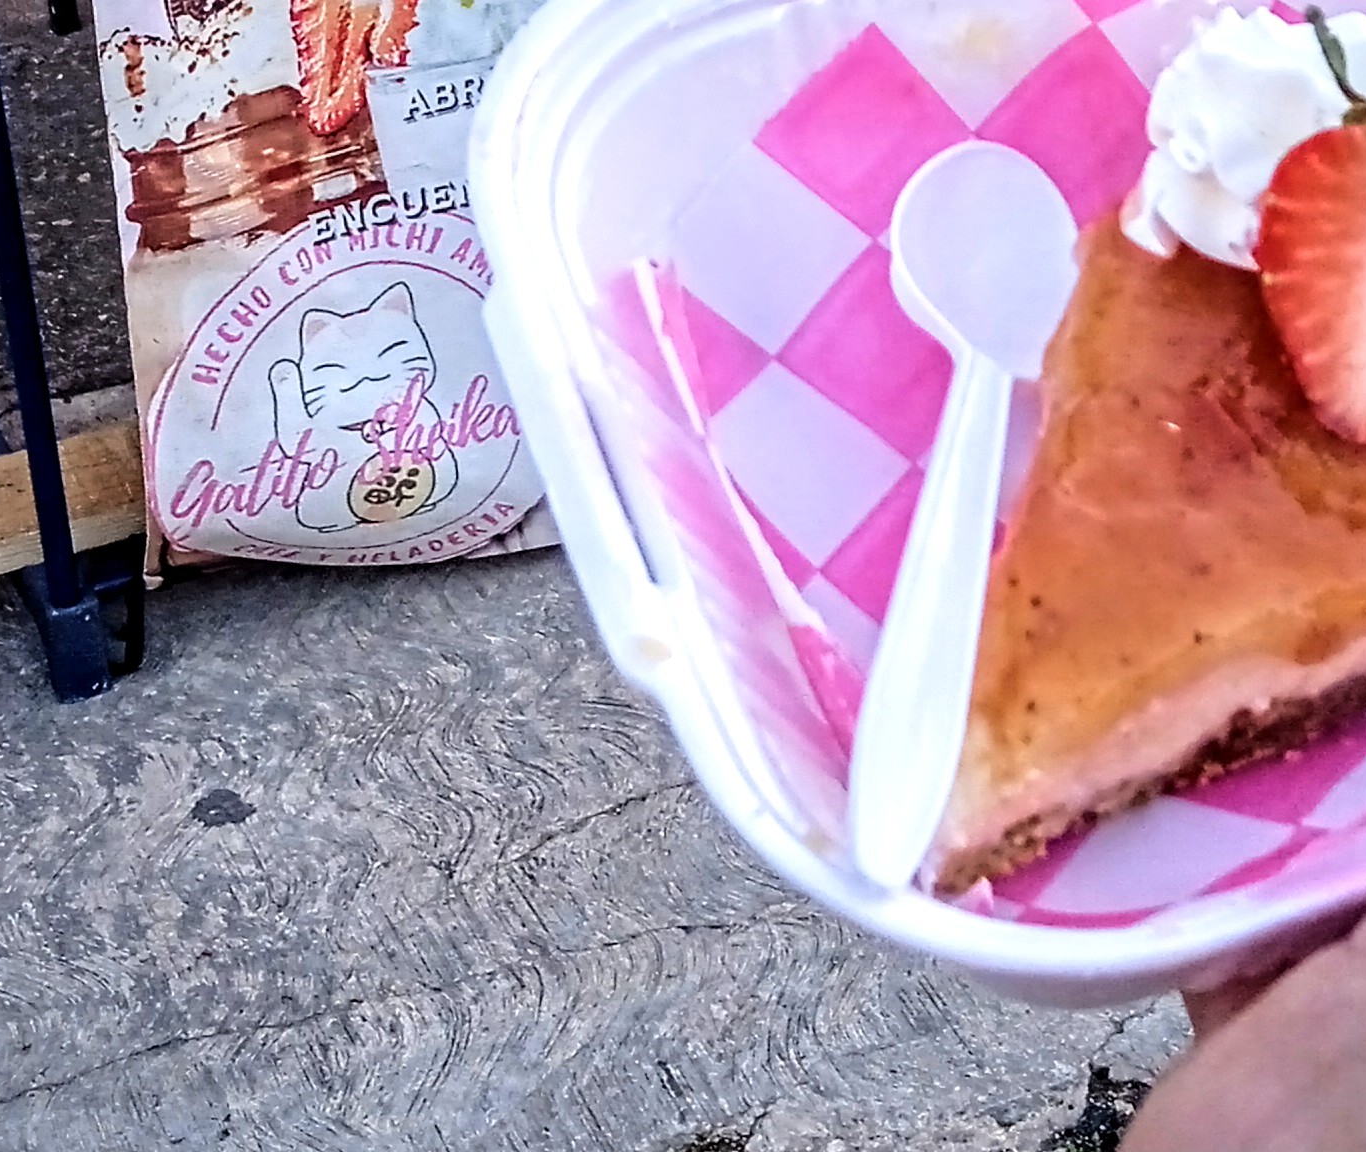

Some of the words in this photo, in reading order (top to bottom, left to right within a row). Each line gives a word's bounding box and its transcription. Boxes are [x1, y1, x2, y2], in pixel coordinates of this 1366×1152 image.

[402, 74, 485, 125] ABR
[309, 179, 472, 247] ENCUE
[191, 285, 272, 385] HECHO
[278, 240, 333, 286] CON
[347, 221, 444, 255] MICHI
[450, 237, 495, 287] AM
[169, 427, 347, 543] Gatito
[355, 371, 521, 486] Sheika
